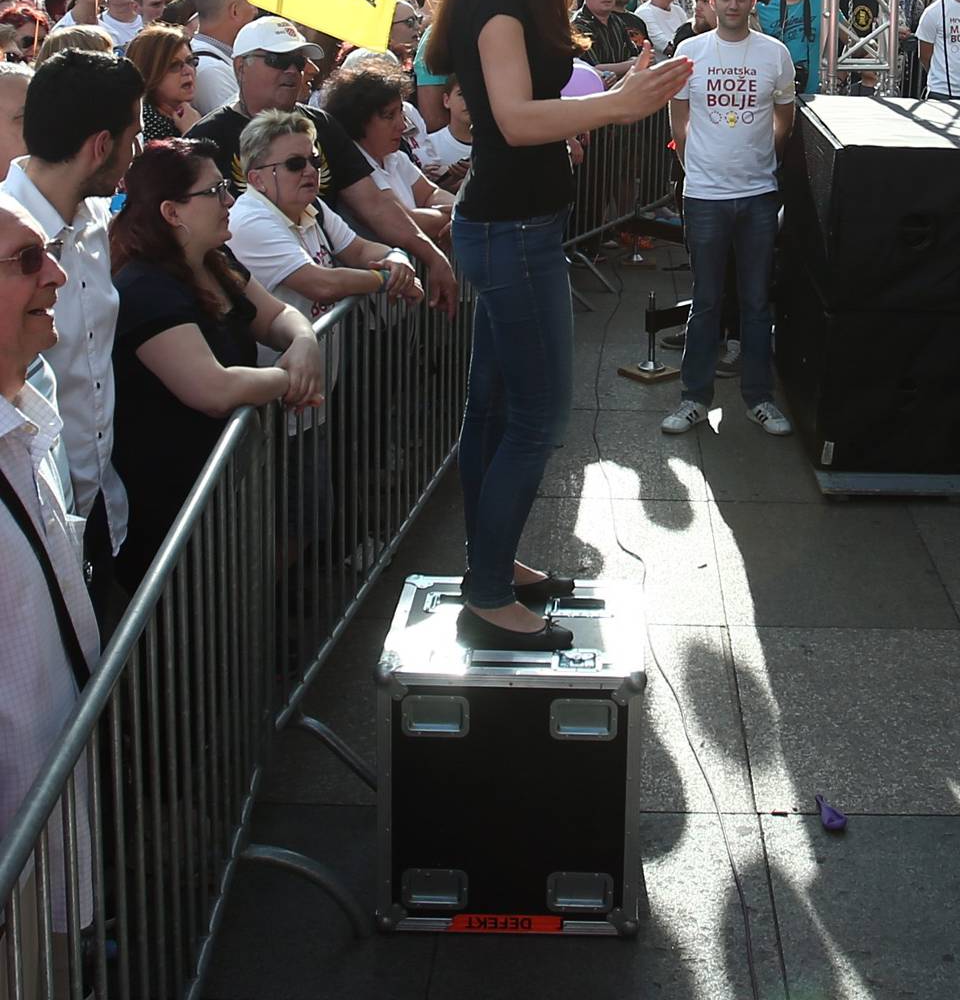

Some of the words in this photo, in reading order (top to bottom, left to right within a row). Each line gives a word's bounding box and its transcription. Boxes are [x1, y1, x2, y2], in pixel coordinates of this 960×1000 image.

[707, 66, 758, 76] Hrvatska
[707, 75, 758, 92] MOŽE
[707, 93, 757, 110] BOLJE
[465, 916, 532, 930] DEFEKT
